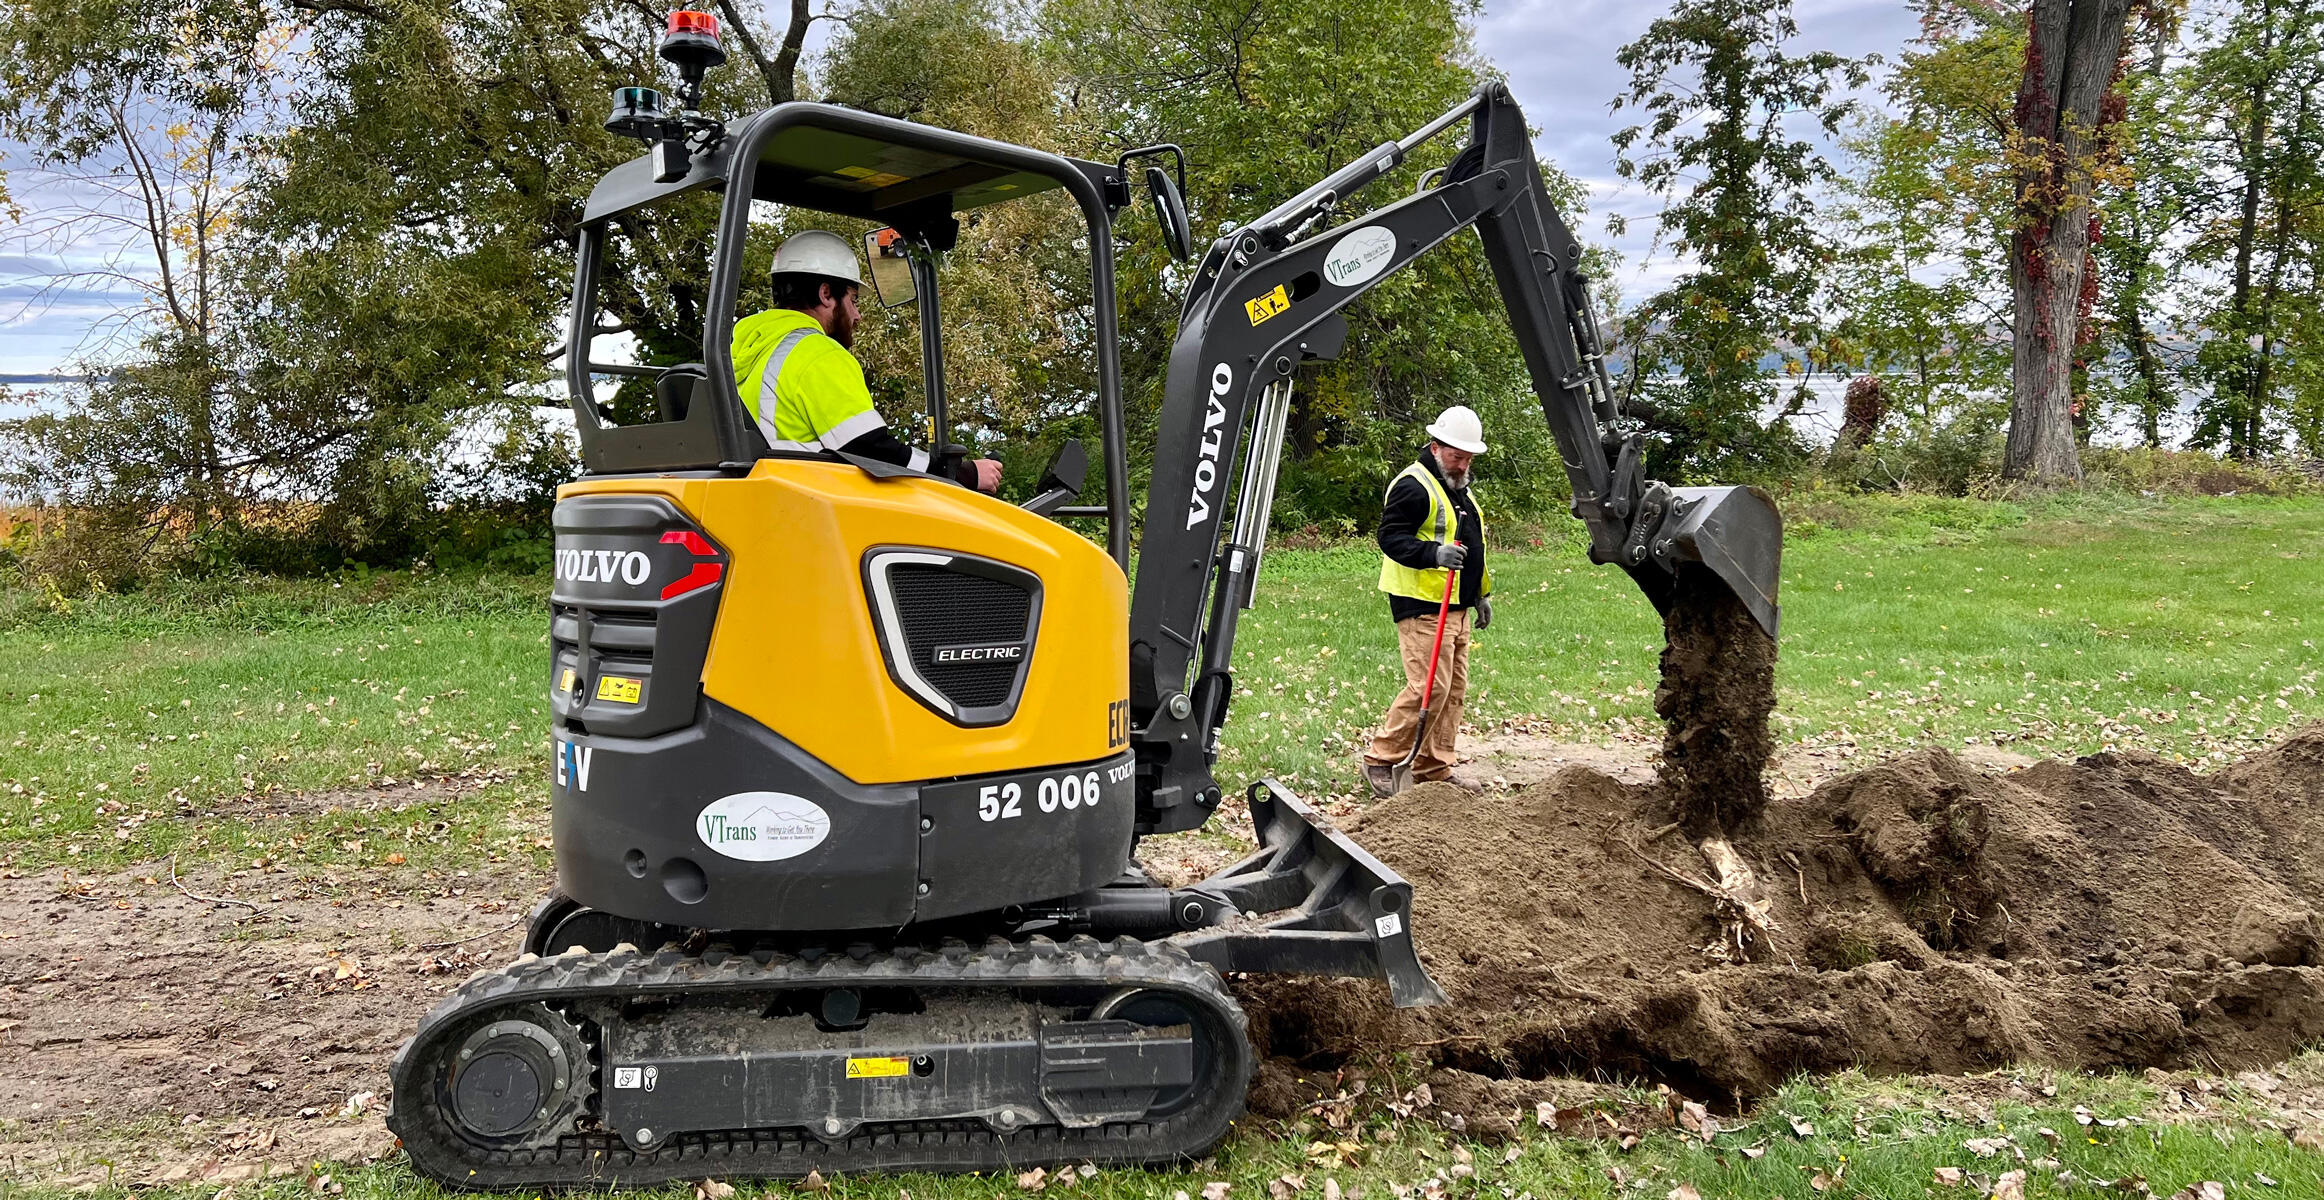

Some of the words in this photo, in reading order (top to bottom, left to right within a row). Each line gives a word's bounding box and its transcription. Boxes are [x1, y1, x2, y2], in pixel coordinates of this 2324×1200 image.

[1327, 258, 1361, 282] VTrans
[1186, 362, 1232, 531] VOLVO
[555, 549, 651, 585] VOLVO
[938, 646, 1021, 662] ELECTRIC
[978, 782, 1022, 822] 52
[1037, 771, 1101, 813] 006
[704, 815, 757, 843] VTrans
